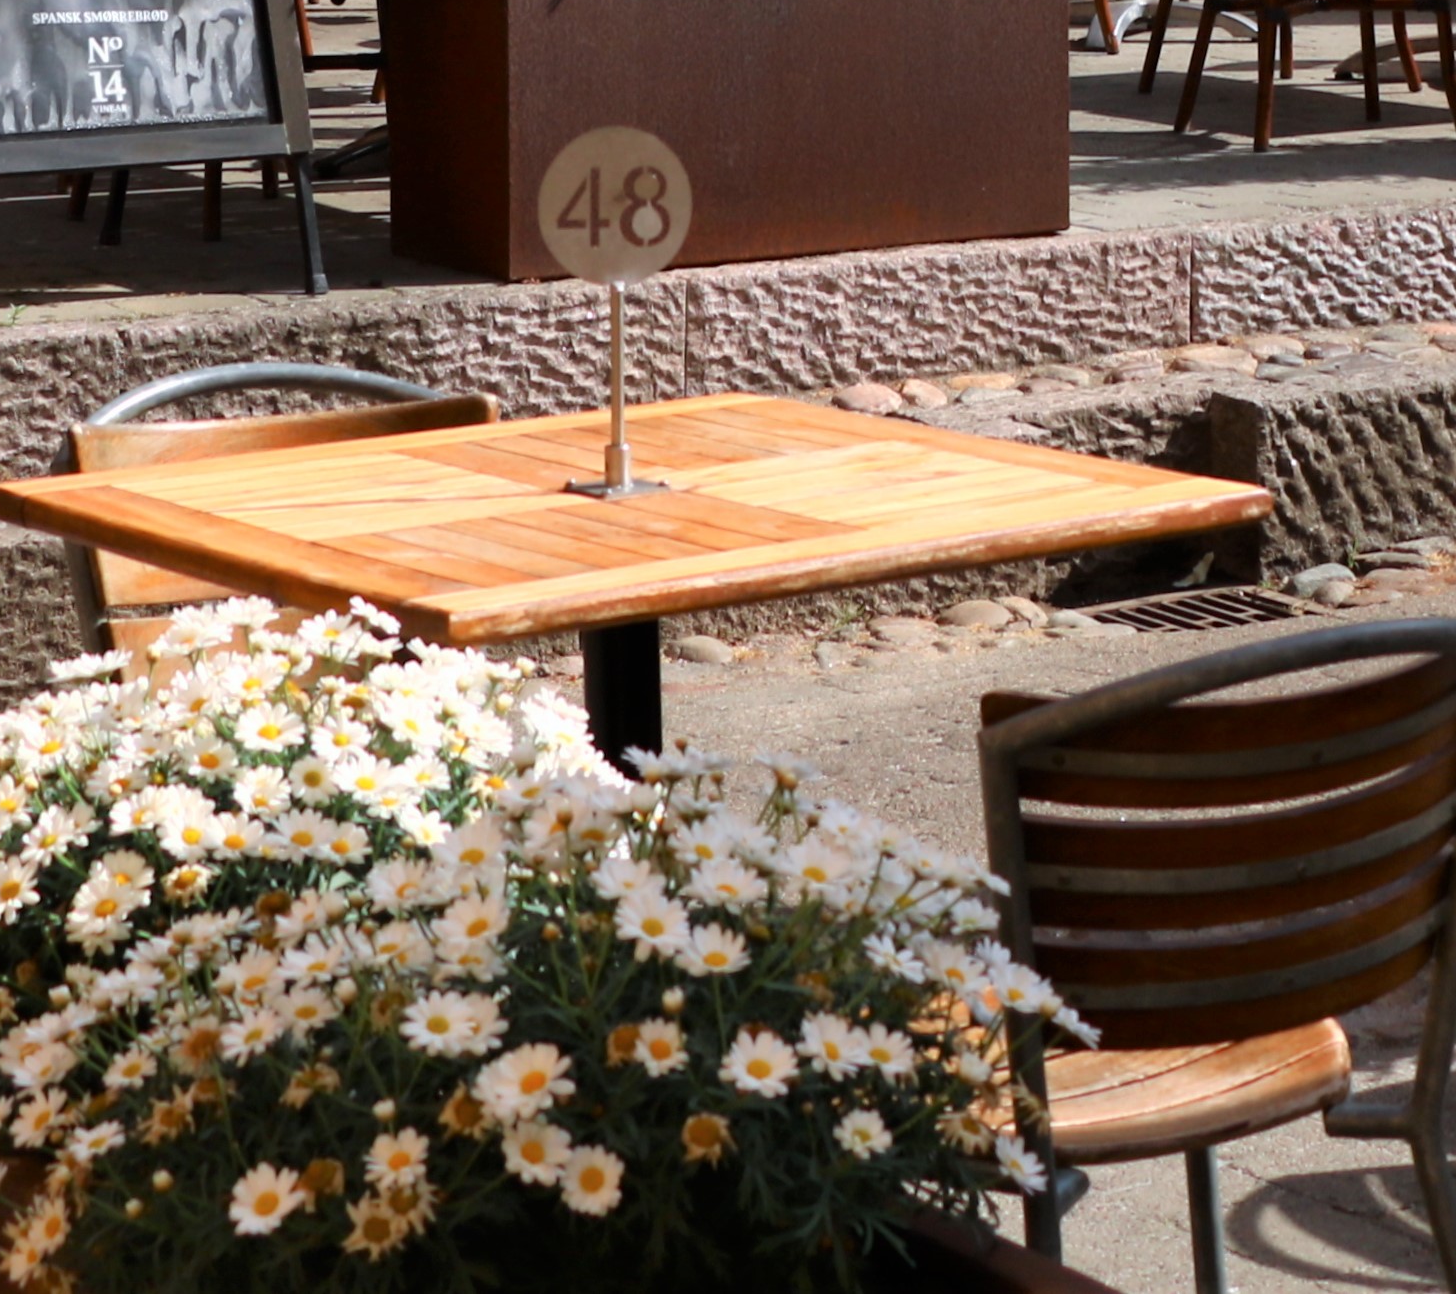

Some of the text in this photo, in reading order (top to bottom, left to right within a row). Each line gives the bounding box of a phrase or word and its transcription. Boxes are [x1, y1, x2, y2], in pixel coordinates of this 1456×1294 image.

[31, 9, 169, 25] SPANSK SMØRREBRØD
[87, 69, 127, 104] 14
[556, 165, 672, 248] 48
